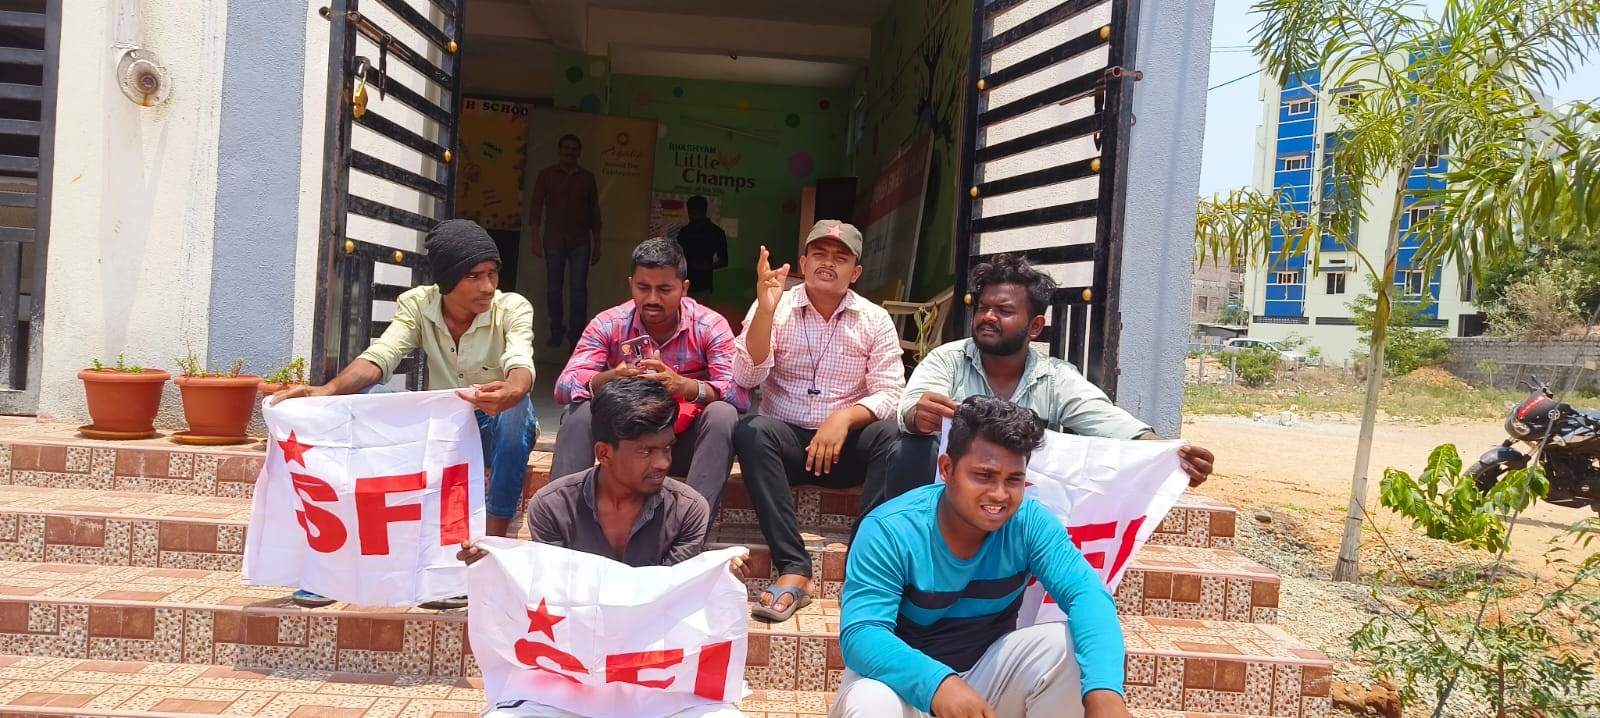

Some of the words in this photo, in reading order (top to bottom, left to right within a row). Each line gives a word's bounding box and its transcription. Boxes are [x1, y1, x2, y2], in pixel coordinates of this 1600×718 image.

[674, 151, 720, 169] Little
[682, 168, 755, 192] Champs
[291, 464, 470, 556] SFI
